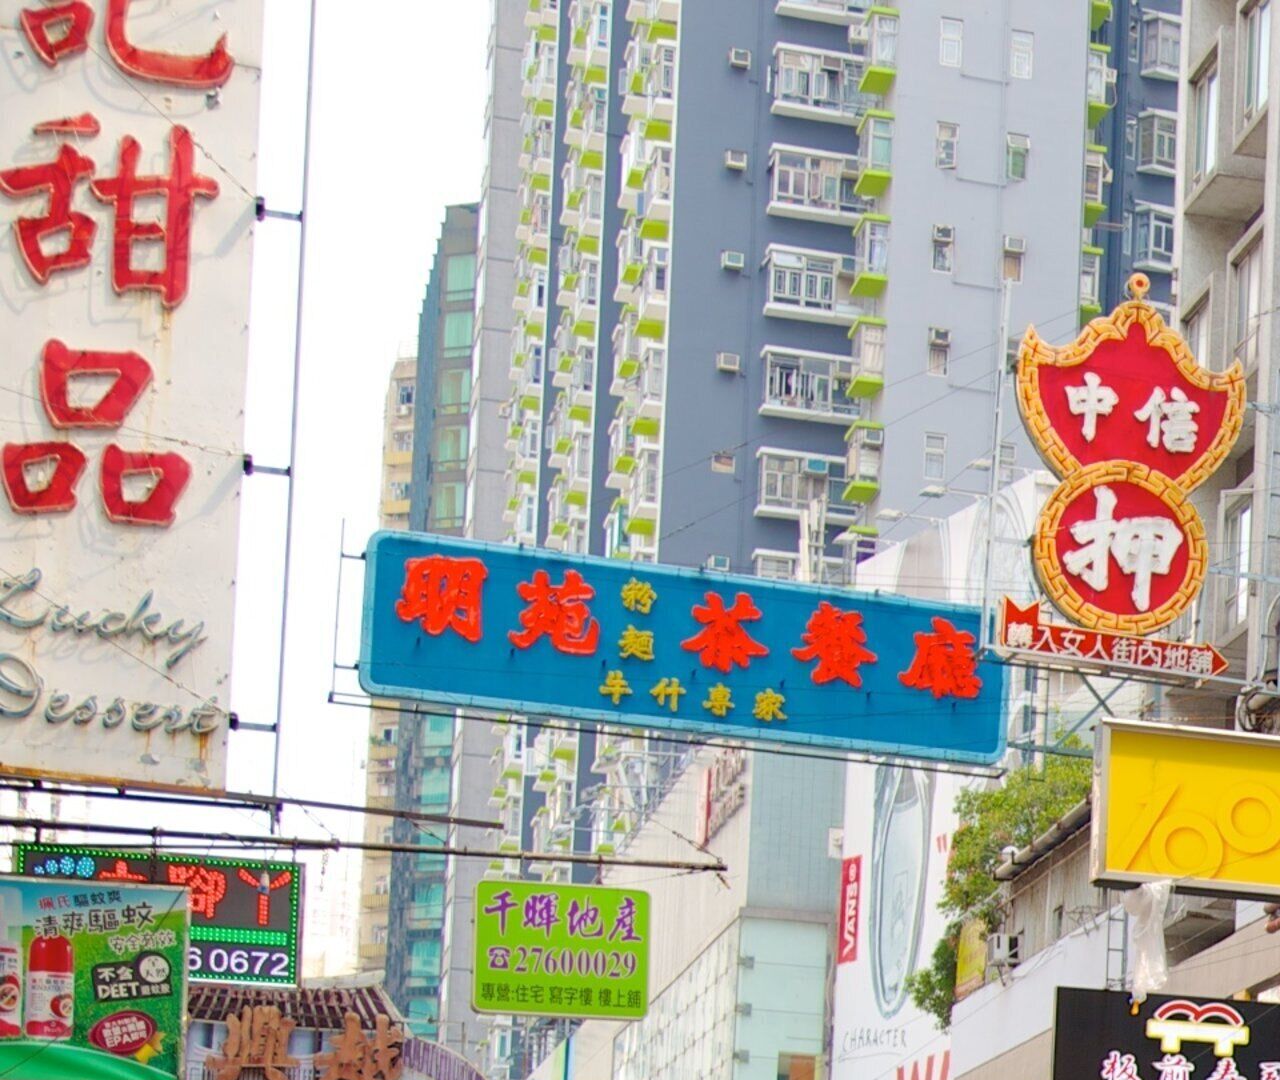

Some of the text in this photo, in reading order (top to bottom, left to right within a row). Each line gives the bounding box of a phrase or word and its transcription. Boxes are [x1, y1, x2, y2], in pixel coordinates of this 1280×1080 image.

[1064, 372, 1200, 453] 中信
[1063, 486, 1184, 612] 押
[396, 555, 983, 700] 明苑茶餐廳
[35, 902, 155, 937] 清爽驅蚊
[843, 881, 857, 958] VANS
[209, 949, 290, 977] 0672
[515, 946, 636, 978] 27600029
[97, 982, 139, 1000] DEET
[550, 986, 593, 1006] 寫字樓
[599, 989, 641, 1008] 樓上舖
[842, 1028, 907, 1056] CHARACTER
